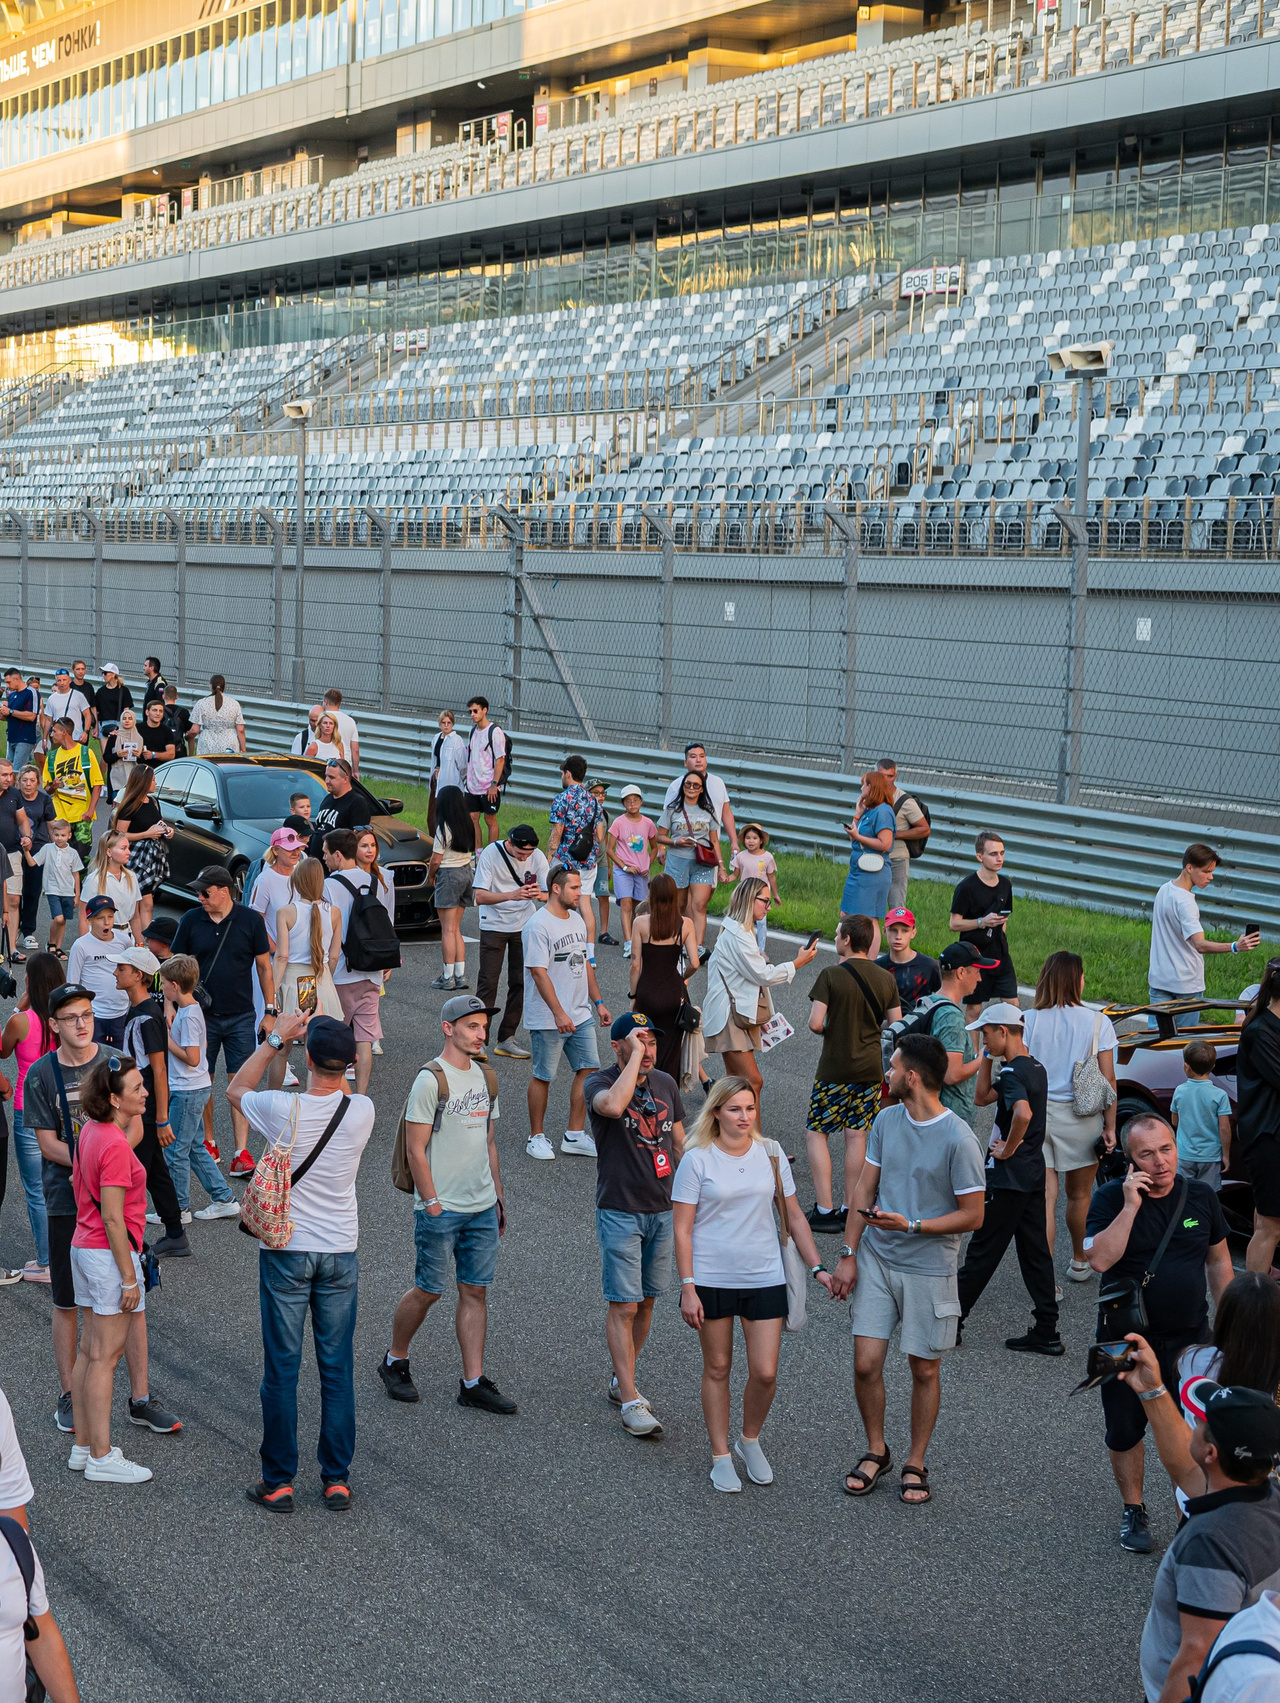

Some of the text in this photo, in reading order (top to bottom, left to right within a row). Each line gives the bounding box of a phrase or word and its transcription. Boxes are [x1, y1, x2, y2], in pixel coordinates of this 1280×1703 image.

[32, 38, 56, 69] ЧЕМ
[58, 20, 101, 60] ГОНКИ!
[905, 275, 928, 289] 205
[553, 933, 574, 951] WHITE
